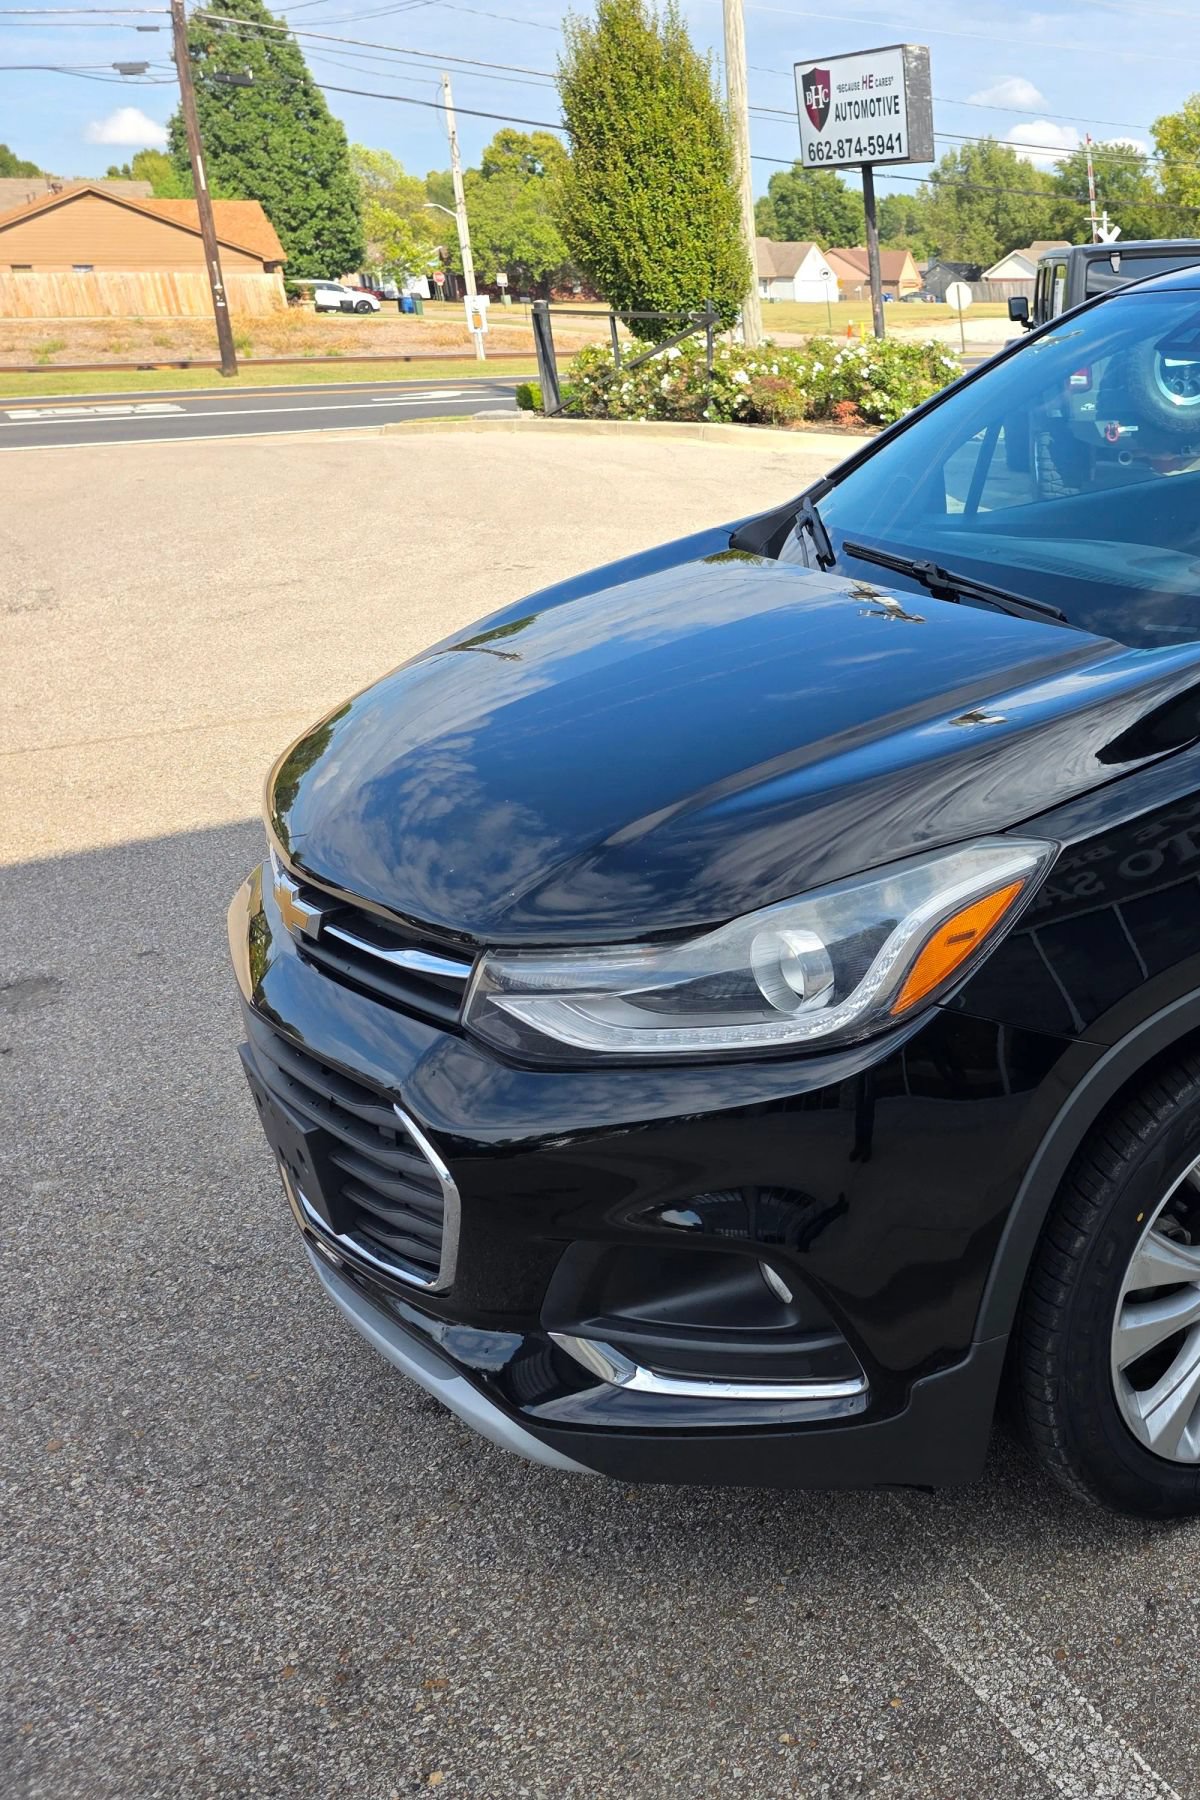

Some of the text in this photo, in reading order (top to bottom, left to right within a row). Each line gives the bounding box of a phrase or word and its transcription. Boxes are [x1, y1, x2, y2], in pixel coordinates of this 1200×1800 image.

[861, 74, 874, 90] HE
[806, 84, 829, 110] BHC
[834, 95, 900, 122] AUTOMOTIVE
[808, 132, 903, 162] 662-874-5941
